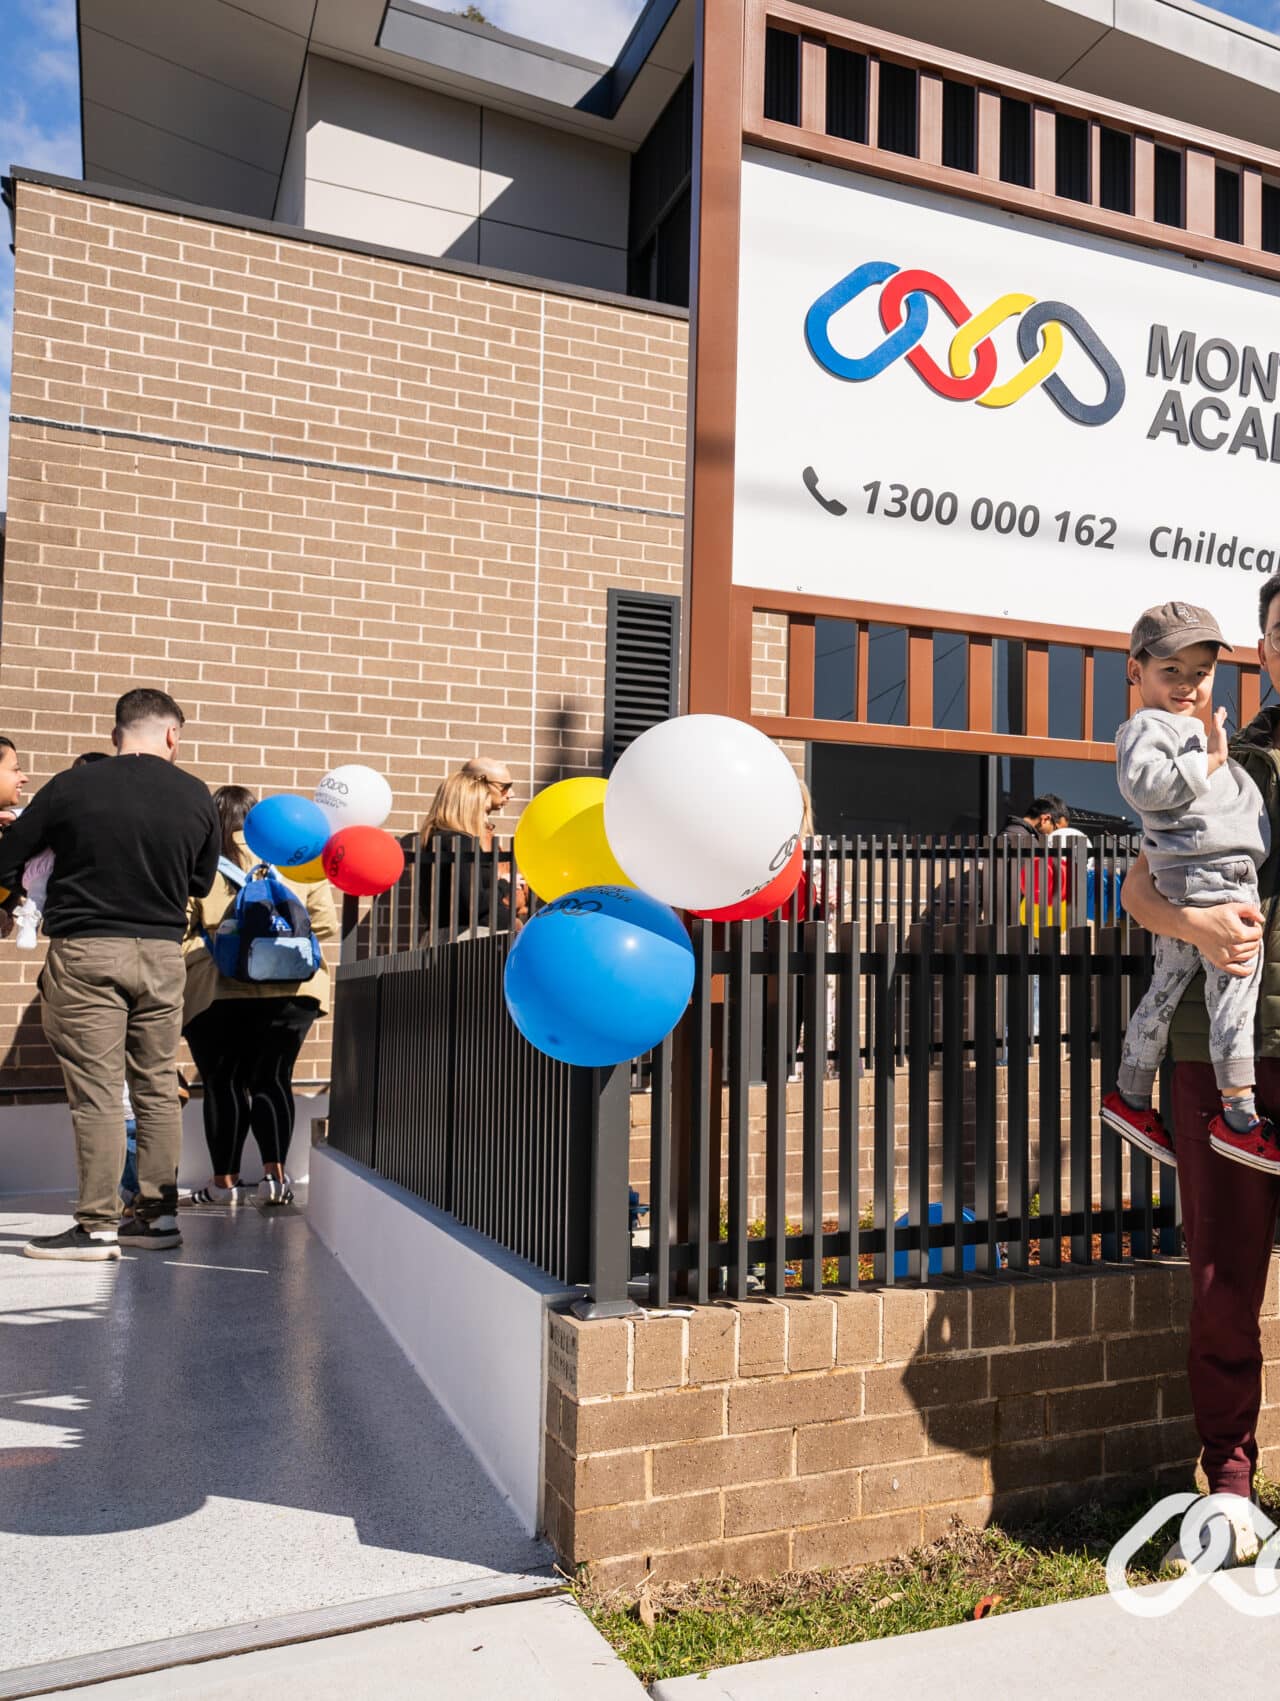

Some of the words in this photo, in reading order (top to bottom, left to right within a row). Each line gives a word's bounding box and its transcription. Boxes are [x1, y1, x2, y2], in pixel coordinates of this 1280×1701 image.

[863, 480, 959, 526] 1300
[970, 497, 1040, 538] 000
[1053, 510, 1118, 550] 162
